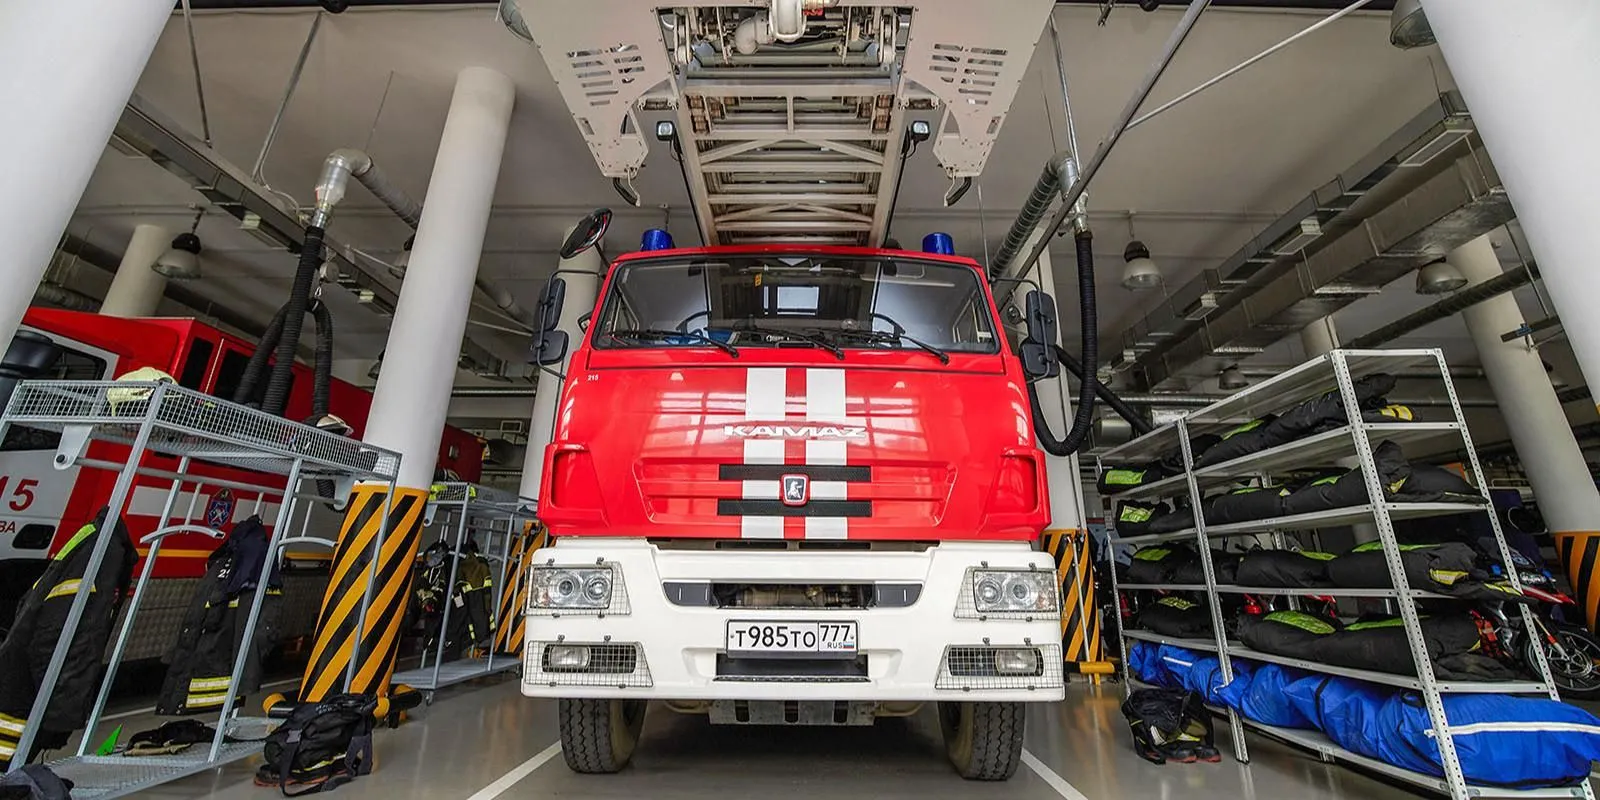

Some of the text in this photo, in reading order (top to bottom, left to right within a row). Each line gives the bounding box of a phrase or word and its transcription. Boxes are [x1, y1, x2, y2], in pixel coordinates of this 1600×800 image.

[724, 425, 867, 438] KAMAZ
[820, 624, 850, 642] 777
[827, 641, 843, 649] RUS
